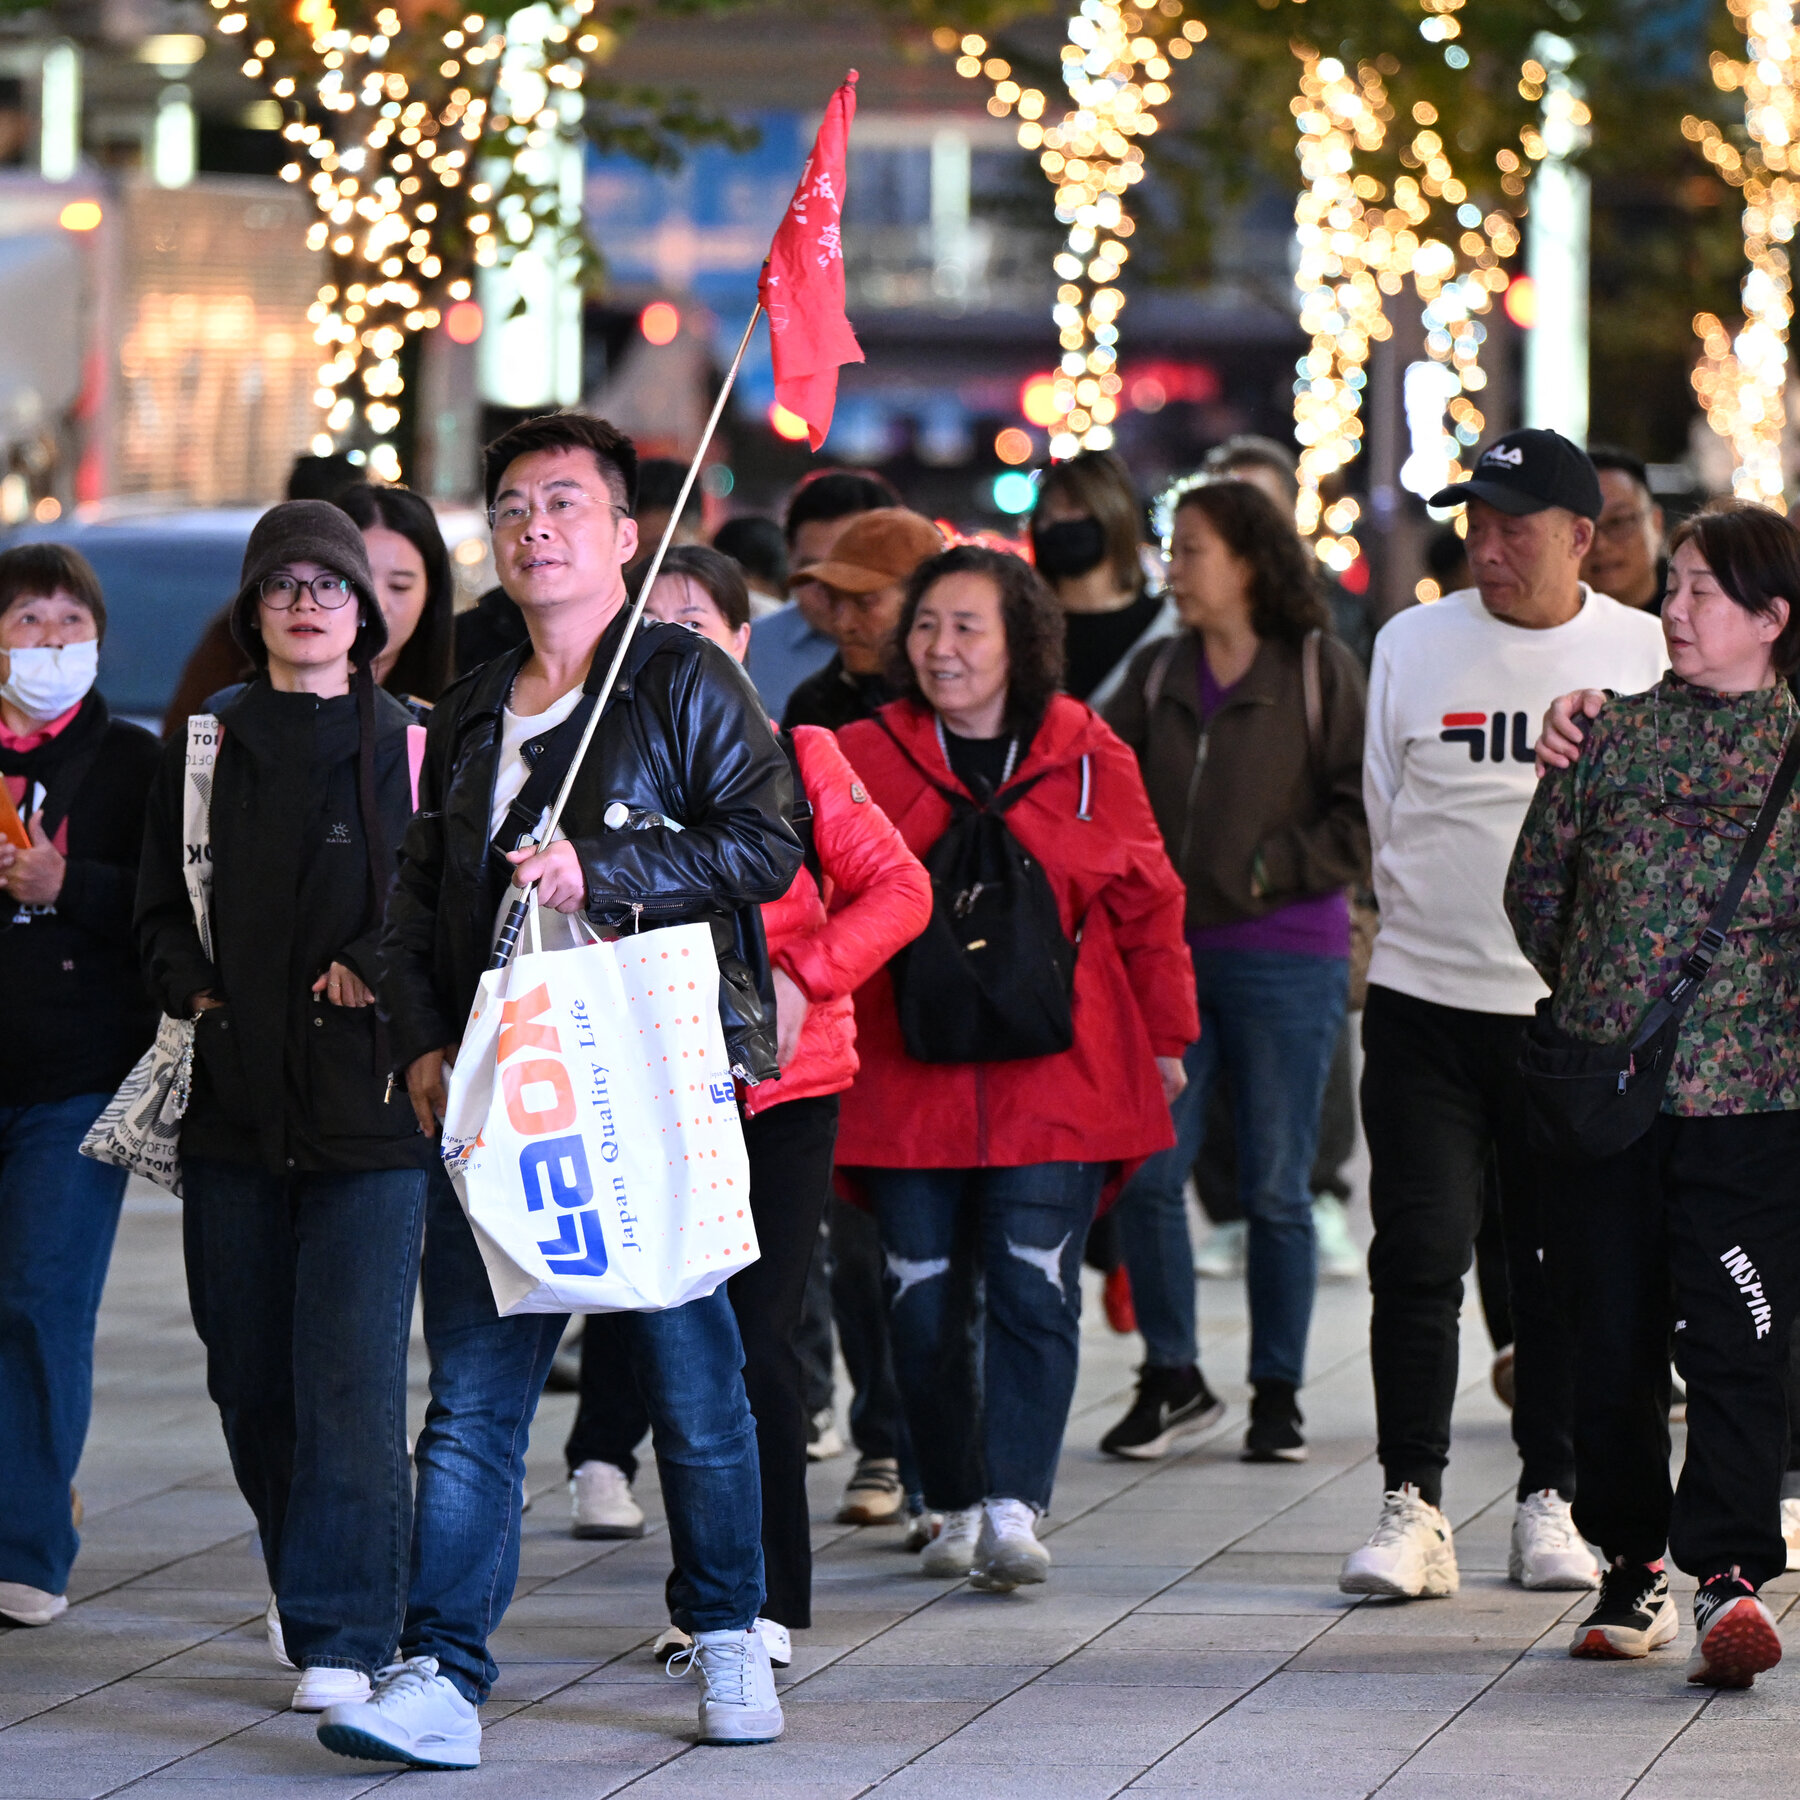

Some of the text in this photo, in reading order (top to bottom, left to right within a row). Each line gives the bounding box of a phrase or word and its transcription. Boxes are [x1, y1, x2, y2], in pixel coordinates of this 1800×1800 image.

[1440, 712, 1536, 763] FIL
[570, 998, 643, 1253] Japan Quality Life
[1720, 1245, 1771, 1340] INSPIRE
